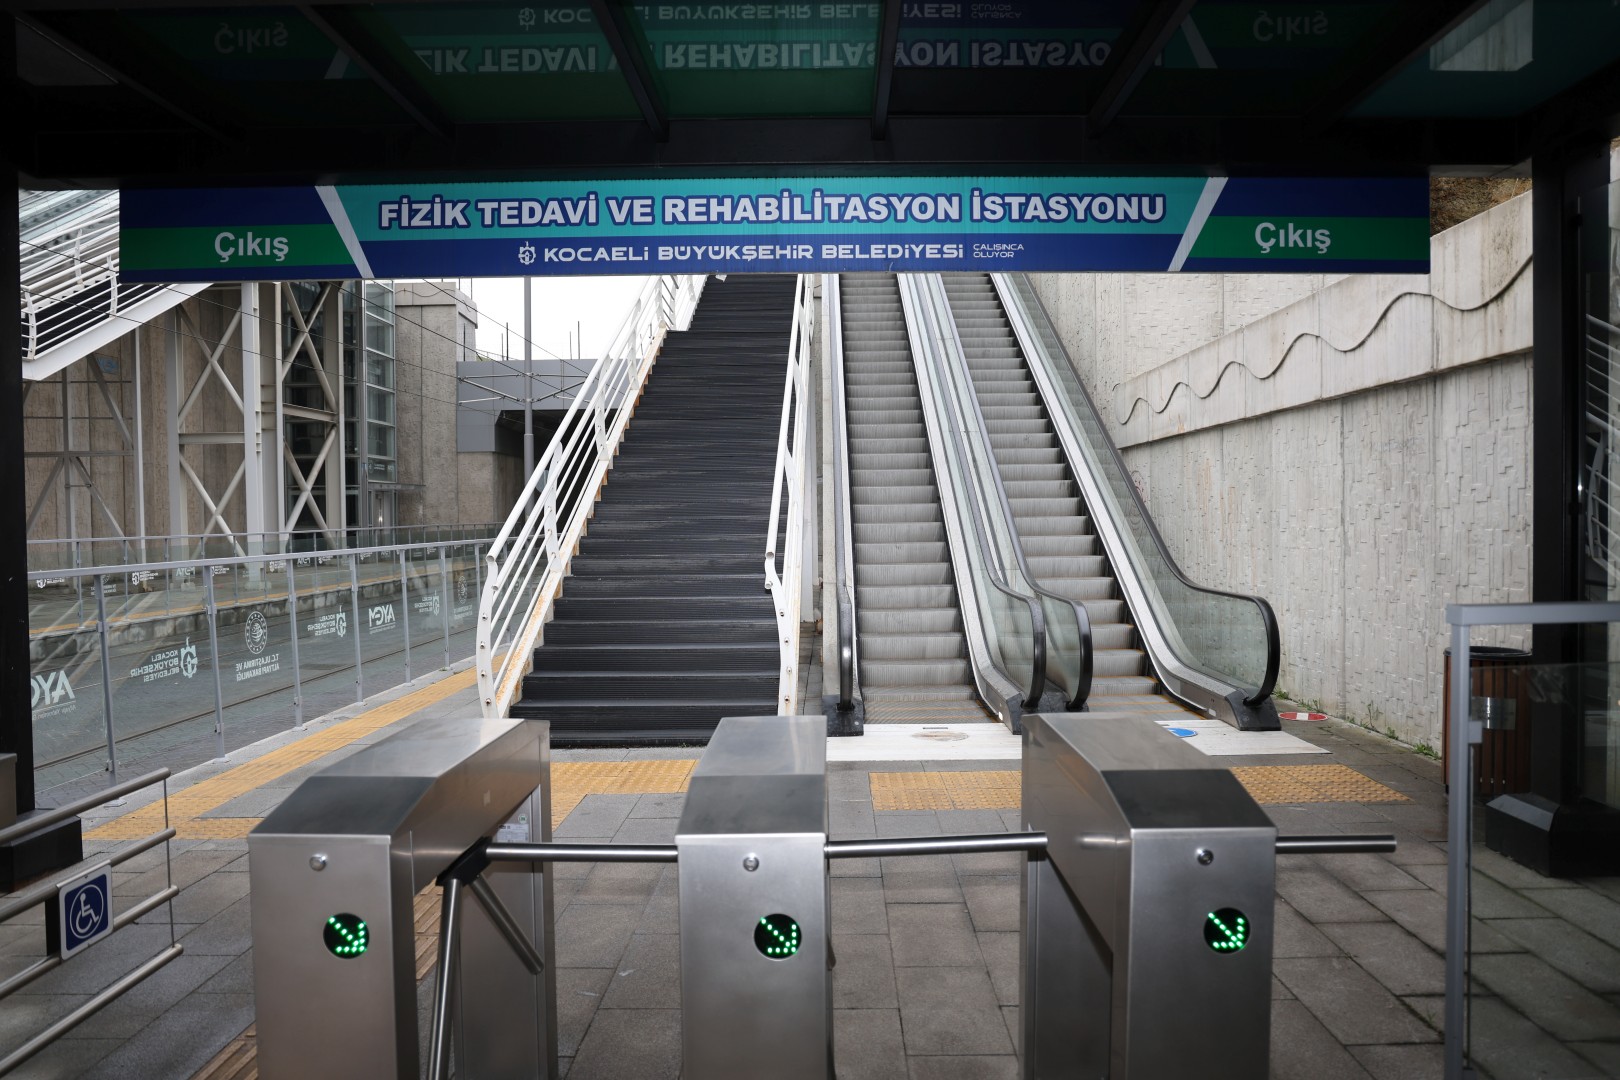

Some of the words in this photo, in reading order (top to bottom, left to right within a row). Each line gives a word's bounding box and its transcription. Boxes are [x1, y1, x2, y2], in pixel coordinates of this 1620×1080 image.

[380, 197, 468, 227] FİZİK
[477, 194, 596, 225] TEDAVİ
[607, 198, 653, 223] VE
[664, 191, 959, 222] REHABİLİTASYON
[972, 190, 1164, 220] İSTASYONU
[214, 231, 289, 263] Çıkış
[1254, 222, 1331, 254] Çıkış
